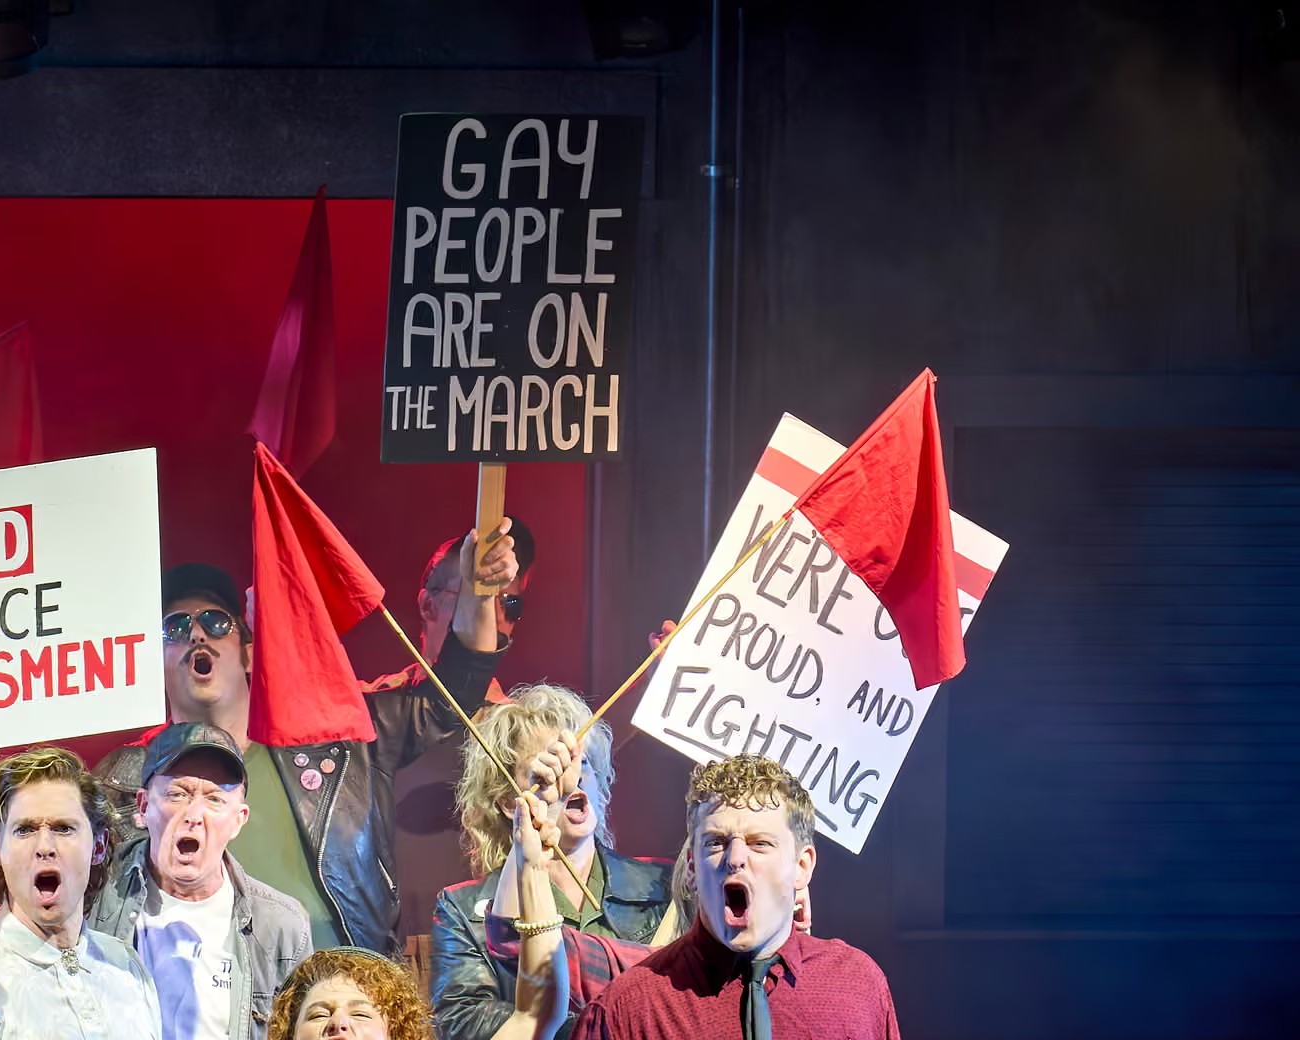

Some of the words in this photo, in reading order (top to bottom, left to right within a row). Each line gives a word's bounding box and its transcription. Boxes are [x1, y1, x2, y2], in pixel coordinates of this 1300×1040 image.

[442, 118, 598, 200] GAY
[403, 206, 622, 284] PEOPLE
[402, 292, 501, 368] ARE
[528, 292, 608, 368] ON
[385, 385, 438, 430] THE
[448, 374, 619, 454] MARCH
[736, 504, 853, 635] WE'RE
[661, 666, 881, 829] FIGHTING
[847, 680, 914, 737] AND
[211, 974, 232, 990] Smi
